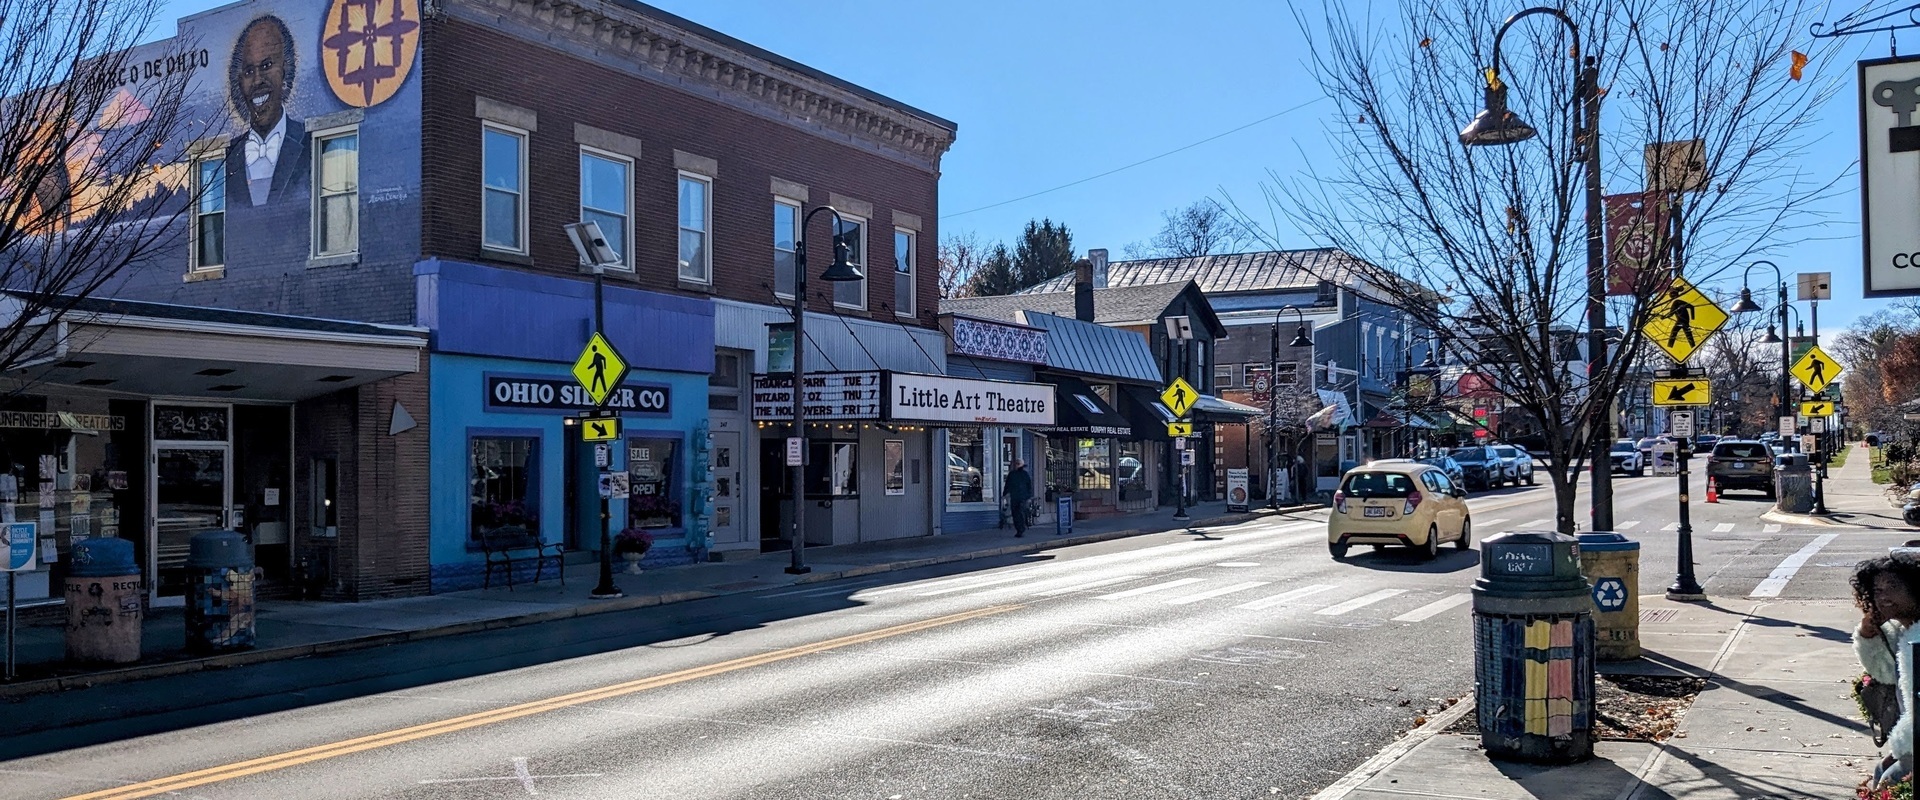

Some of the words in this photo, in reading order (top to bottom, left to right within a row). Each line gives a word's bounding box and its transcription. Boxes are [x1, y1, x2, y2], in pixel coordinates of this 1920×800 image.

[143, 58, 163, 79] DE
[165, 48, 209, 75] OHIO
[843, 376, 861, 386] TUE
[870, 375, 877, 385] 7
[495, 382, 555, 404] OHIO
[560, 385, 636, 407] SILER
[639, 390, 665, 409] CO
[755, 392, 790, 402] WIZARD
[808, 391, 821, 401] OZ
[843, 390, 861, 400] THU
[870, 390, 876, 399] 7
[899, 385, 948, 409] Little
[952, 390, 981, 410] Art
[986, 391, 1045, 413] Theatre
[755, 406, 771, 416] THE
[843, 404, 860, 415] FRI
[869, 404, 876, 414] 7
[172, 416, 209, 431] 243
[632, 449, 648, 459] SALE
[632, 483, 656, 495] OPEN
